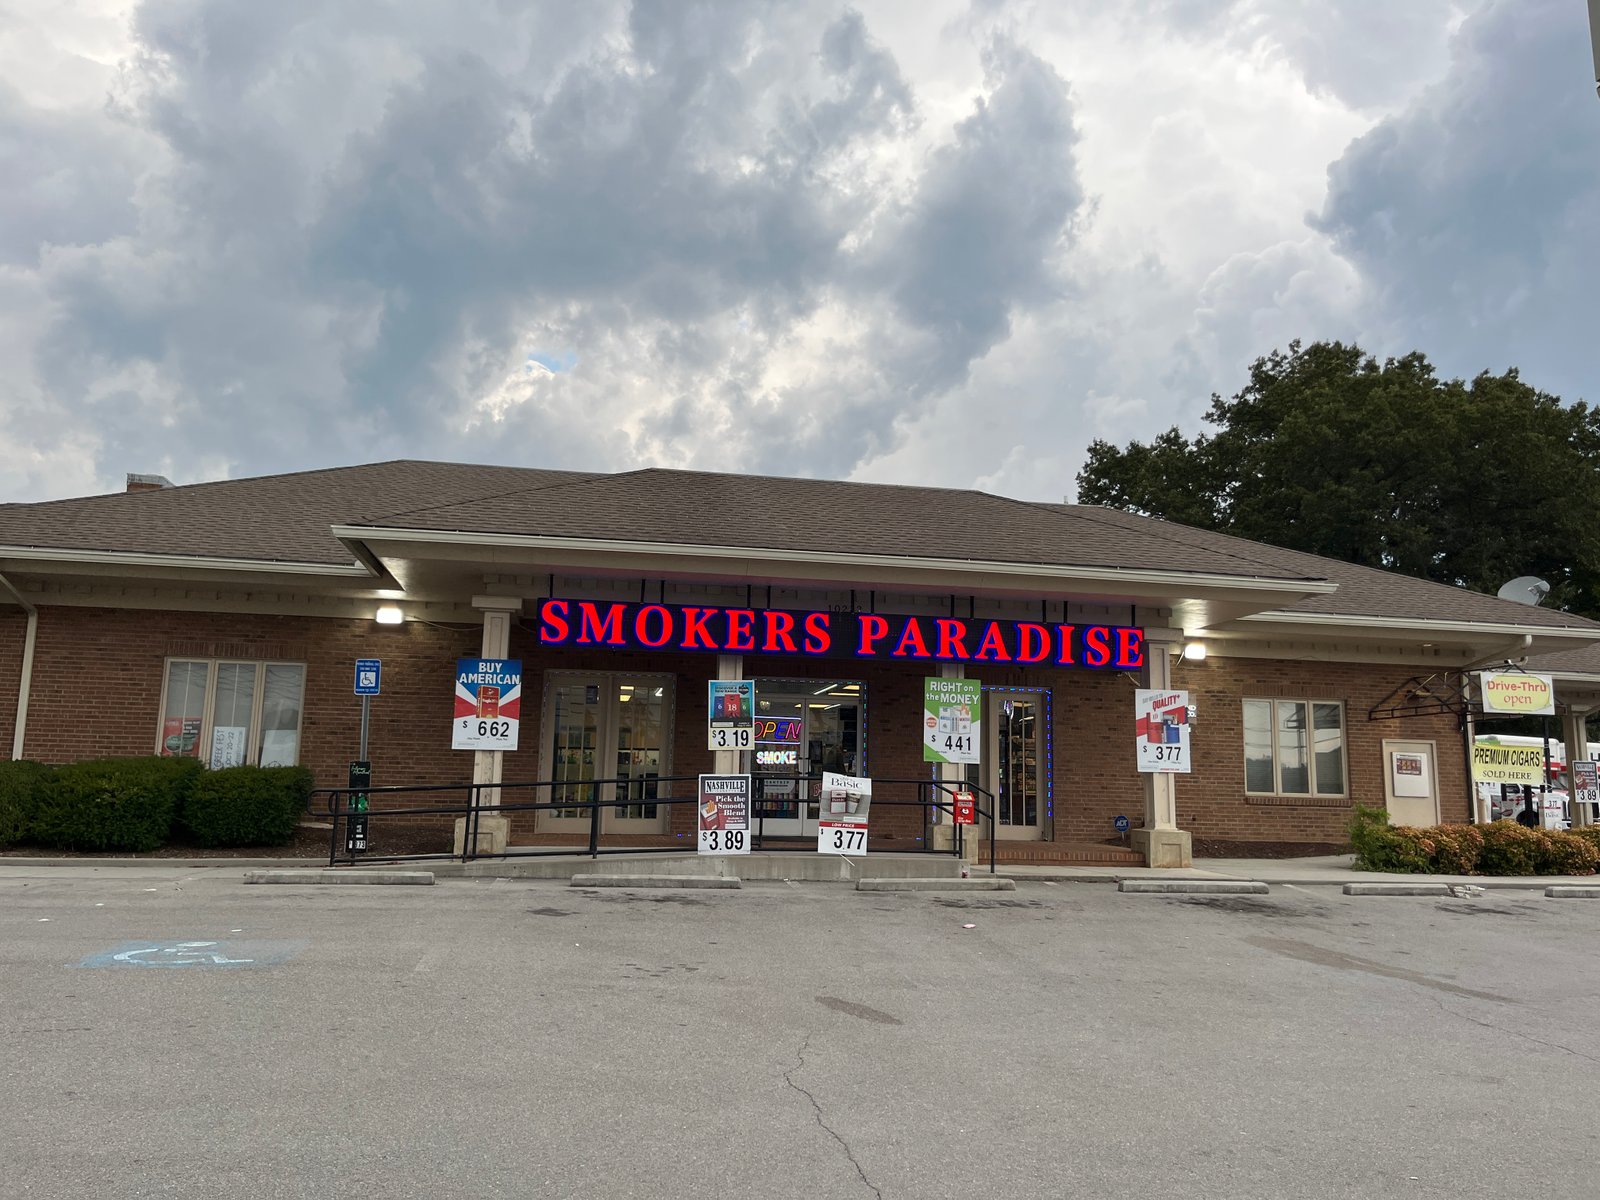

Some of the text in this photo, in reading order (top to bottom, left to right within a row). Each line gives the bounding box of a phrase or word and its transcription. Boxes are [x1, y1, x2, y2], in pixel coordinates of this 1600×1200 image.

[541, 600, 1144, 667] SMOKERS PARADISE
[478, 662, 503, 673] BUY
[459, 672, 520, 685] AMERICAN
[930, 681, 962, 692] RIGHT
[1487, 680, 1547, 692] Drive-Thru
[940, 693, 979, 705] MONEY
[1503, 695, 1532, 706] open
[727, 703, 737, 711] 18
[462, 720, 468, 728] $
[754, 721, 801, 739] OPEN
[226, 731, 234, 750] 20-22
[931, 734, 936, 742] $
[213, 729, 224, 767] GREEK FEST
[1143, 745, 1147, 753] $
[756, 750, 797, 764] SMOKE
[1474, 747, 1541, 767] PREMIUM CIGARS
[1482, 770, 1532, 780] SOLD HERE
[706, 781, 745, 792] NASHVILLE
[831, 777, 863, 789] Basic
